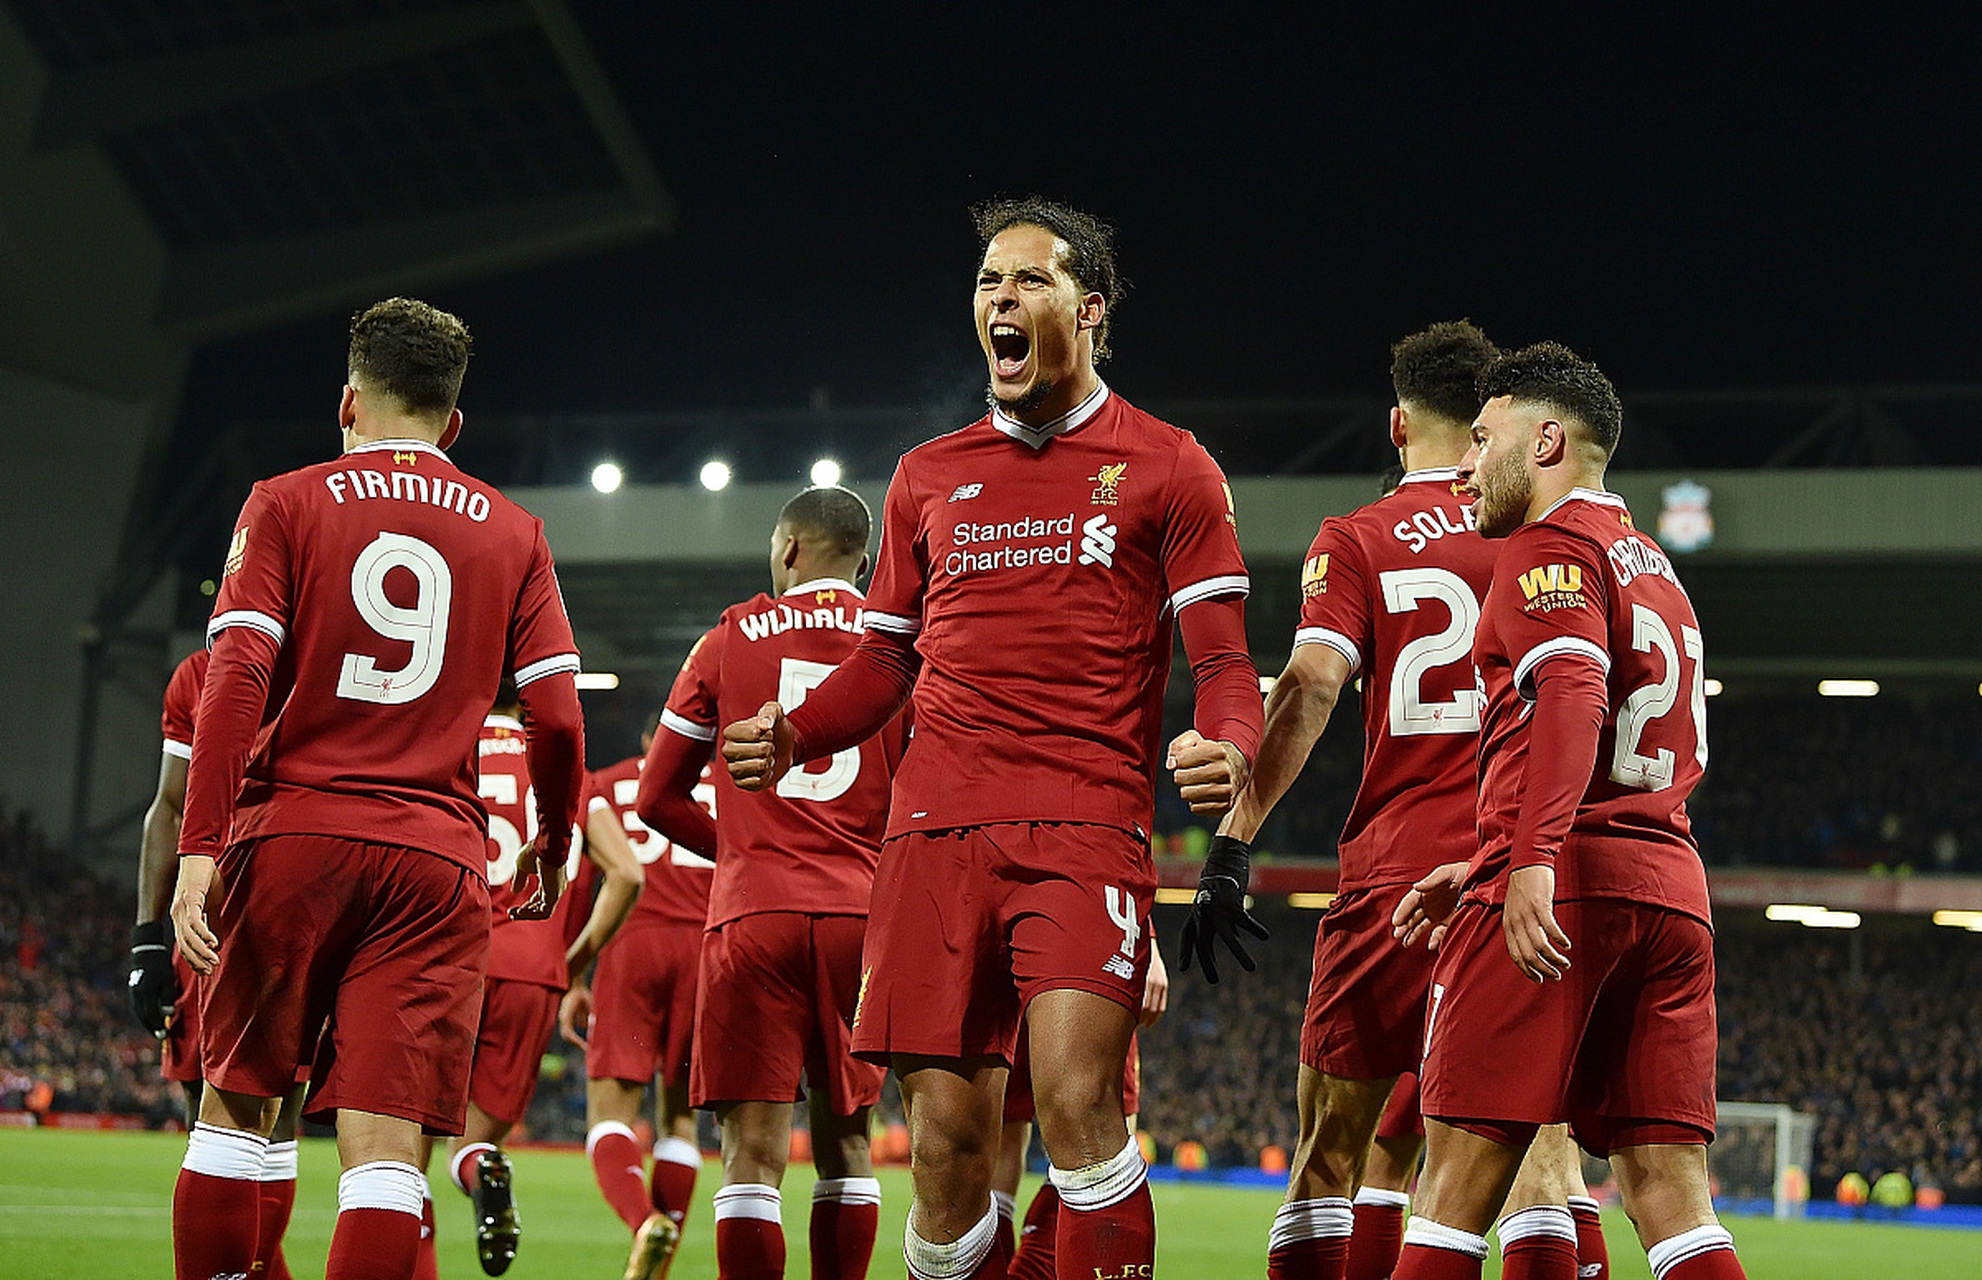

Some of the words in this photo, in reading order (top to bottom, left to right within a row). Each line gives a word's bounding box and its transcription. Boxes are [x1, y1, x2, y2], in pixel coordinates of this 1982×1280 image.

[325, 469, 491, 522] FIRMINO
[953, 513, 1074, 546] Standard
[945, 541, 1071, 576] Chartered
[1518, 564, 1582, 600] WU
[336, 531, 452, 704] 9
[1524, 593, 1585, 612] WESTERN
[1542, 600, 1587, 613] UNION
[1104, 884, 1141, 959] 4
